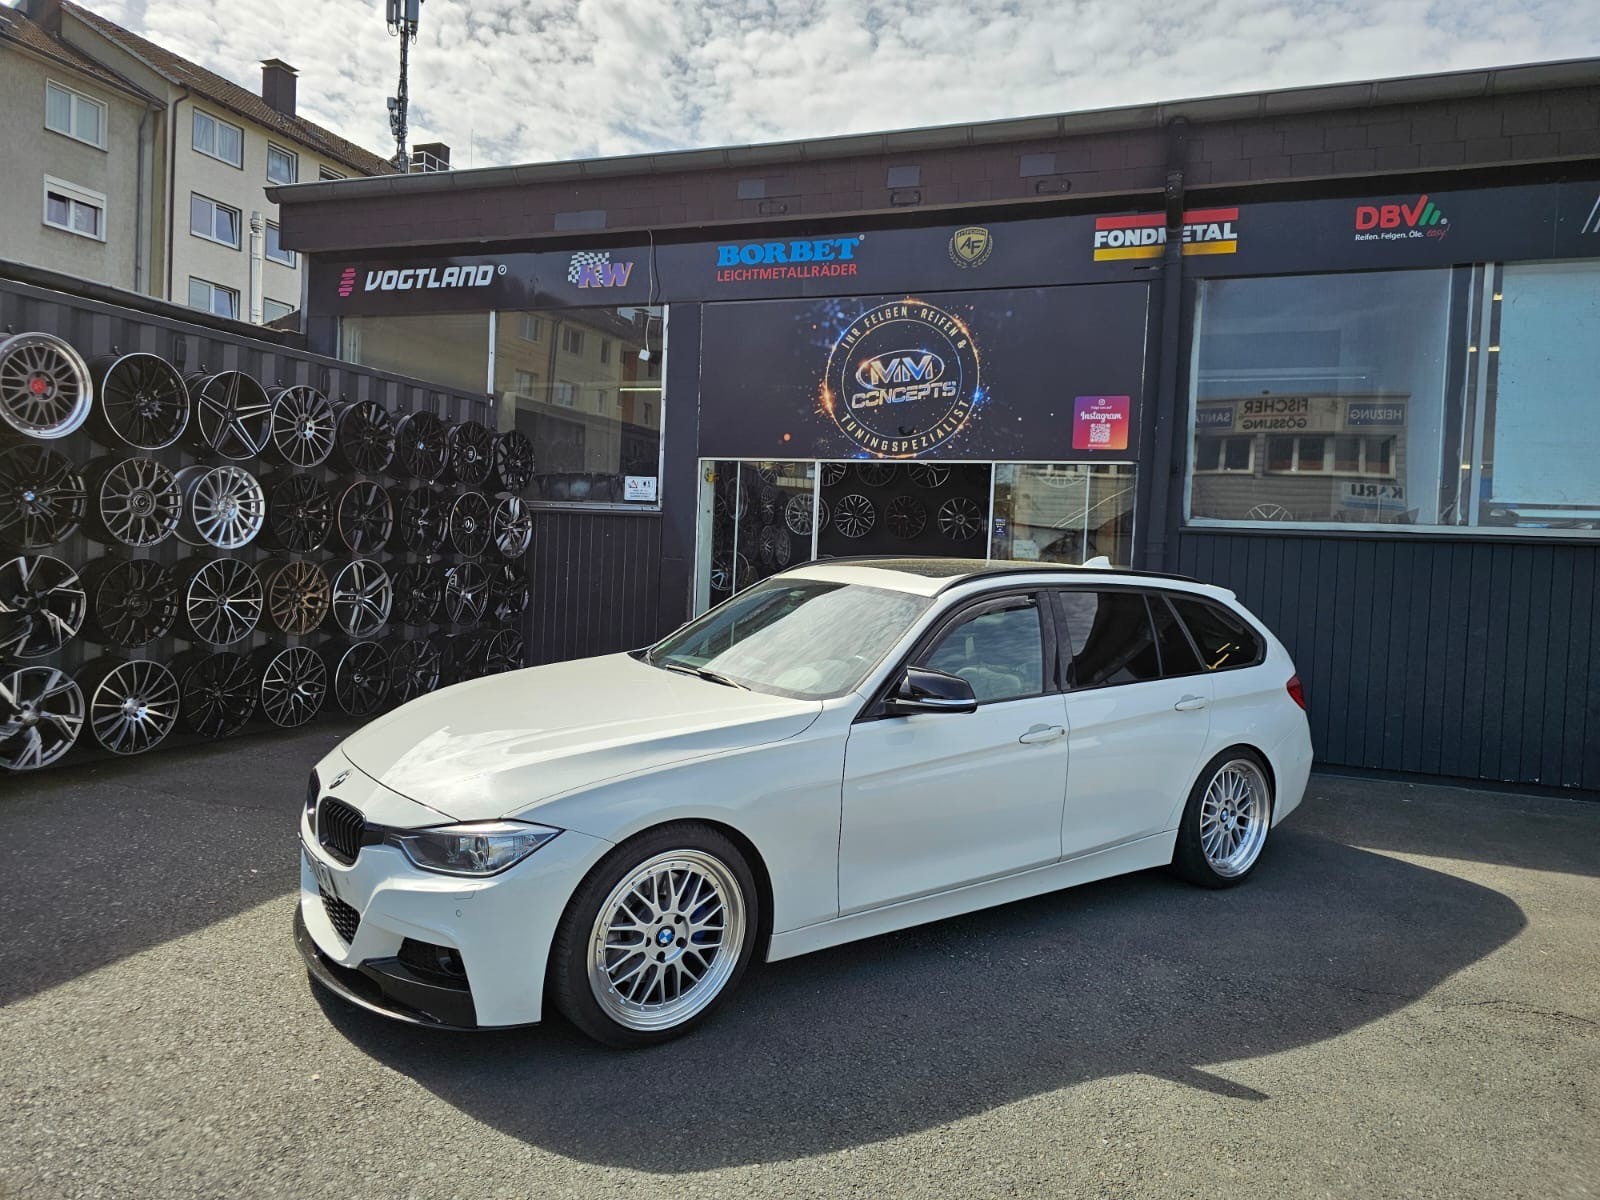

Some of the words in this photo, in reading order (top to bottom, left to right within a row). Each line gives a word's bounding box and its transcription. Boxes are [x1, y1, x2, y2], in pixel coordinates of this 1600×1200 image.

[1355, 194, 1428, 230] DBV
[960, 236, 984, 255] AF
[1355, 233, 1379, 241] Reifen.
[1381, 231, 1408, 241] Felgen.
[716, 237, 860, 266] BORBET
[365, 265, 494, 291] VOGTLAND
[578, 262, 633, 289] KW
[716, 262, 858, 282] LEICHTMETALLRÄDER
[841, 327, 862, 350] IHR
[864, 306, 908, 328] FELGEN
[920, 308, 959, 337] REIFEN
[957, 339, 968, 349] &
[870, 355, 934, 385] MM
[851, 381, 957, 409] CONCEPTS
[840, 400, 970, 452] TUNINGSPEZIALIST
[1080, 411, 1122, 423] Instagram
